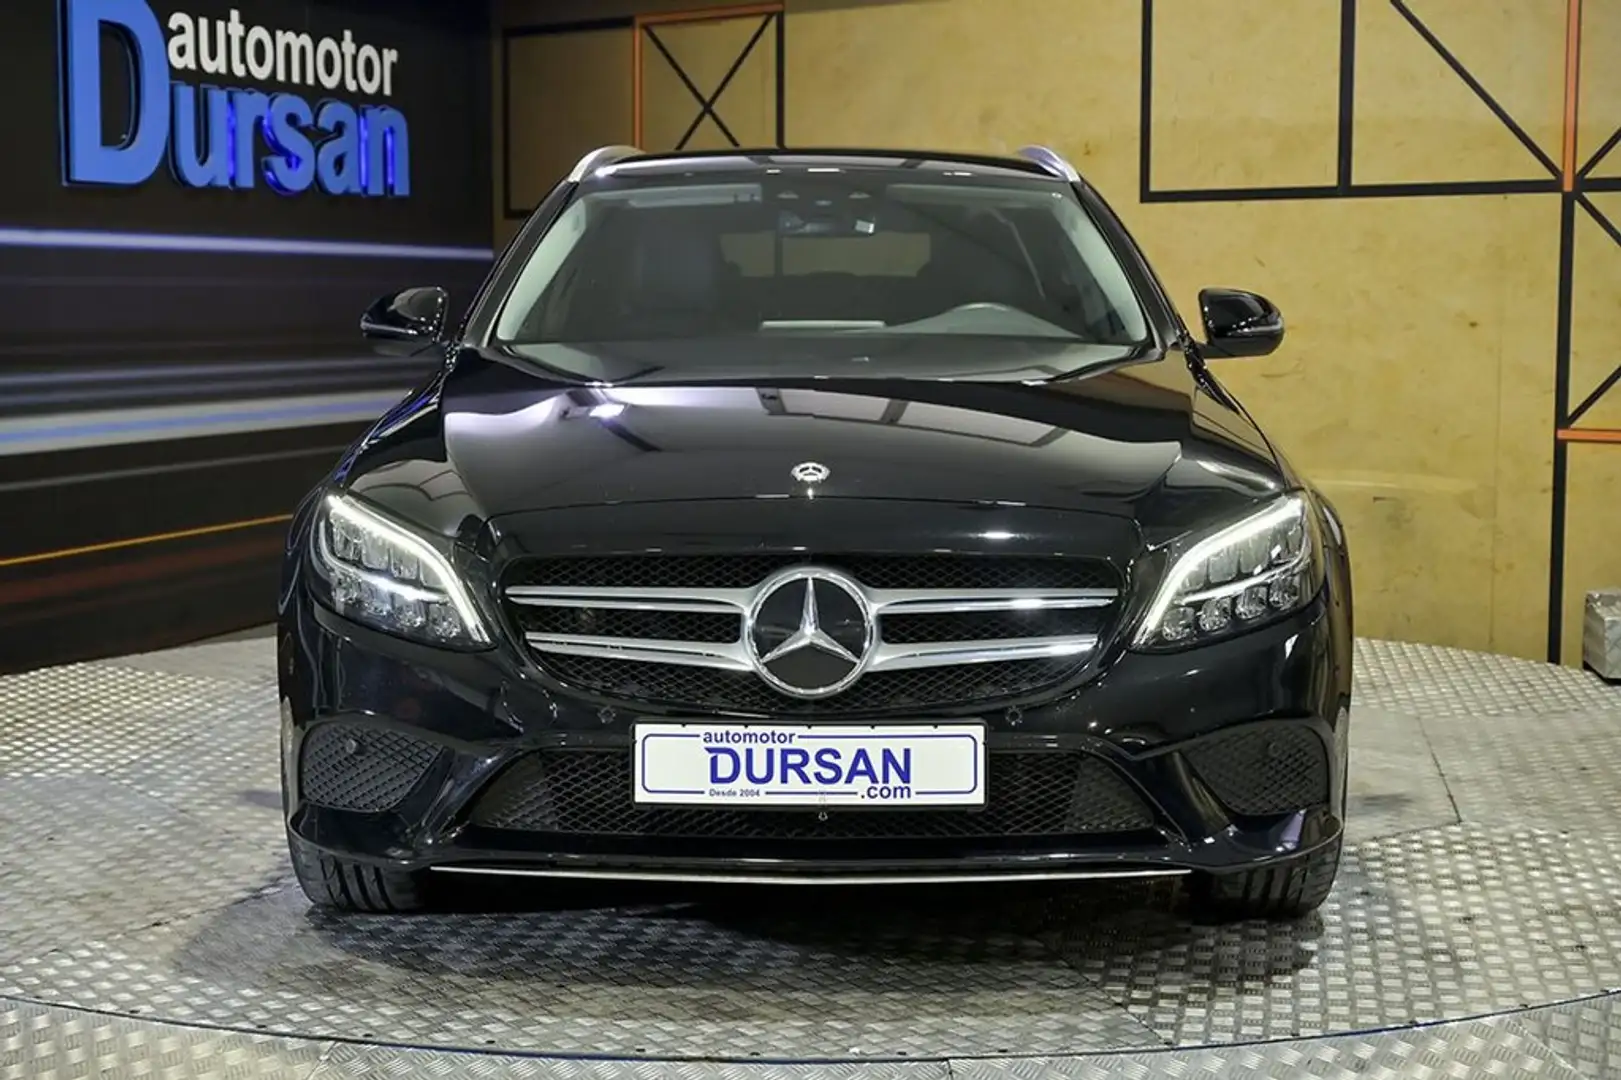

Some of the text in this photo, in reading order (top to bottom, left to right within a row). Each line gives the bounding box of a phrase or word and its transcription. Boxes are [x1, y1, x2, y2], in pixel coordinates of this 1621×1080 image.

[167, 9, 399, 96] automotor
[60, 0, 411, 197] Dursan
[702, 730, 796, 745] automotor
[704, 747, 912, 785] DURSAN
[709, 788, 761, 798] Desde 2004
[860, 785, 911, 800] .com
